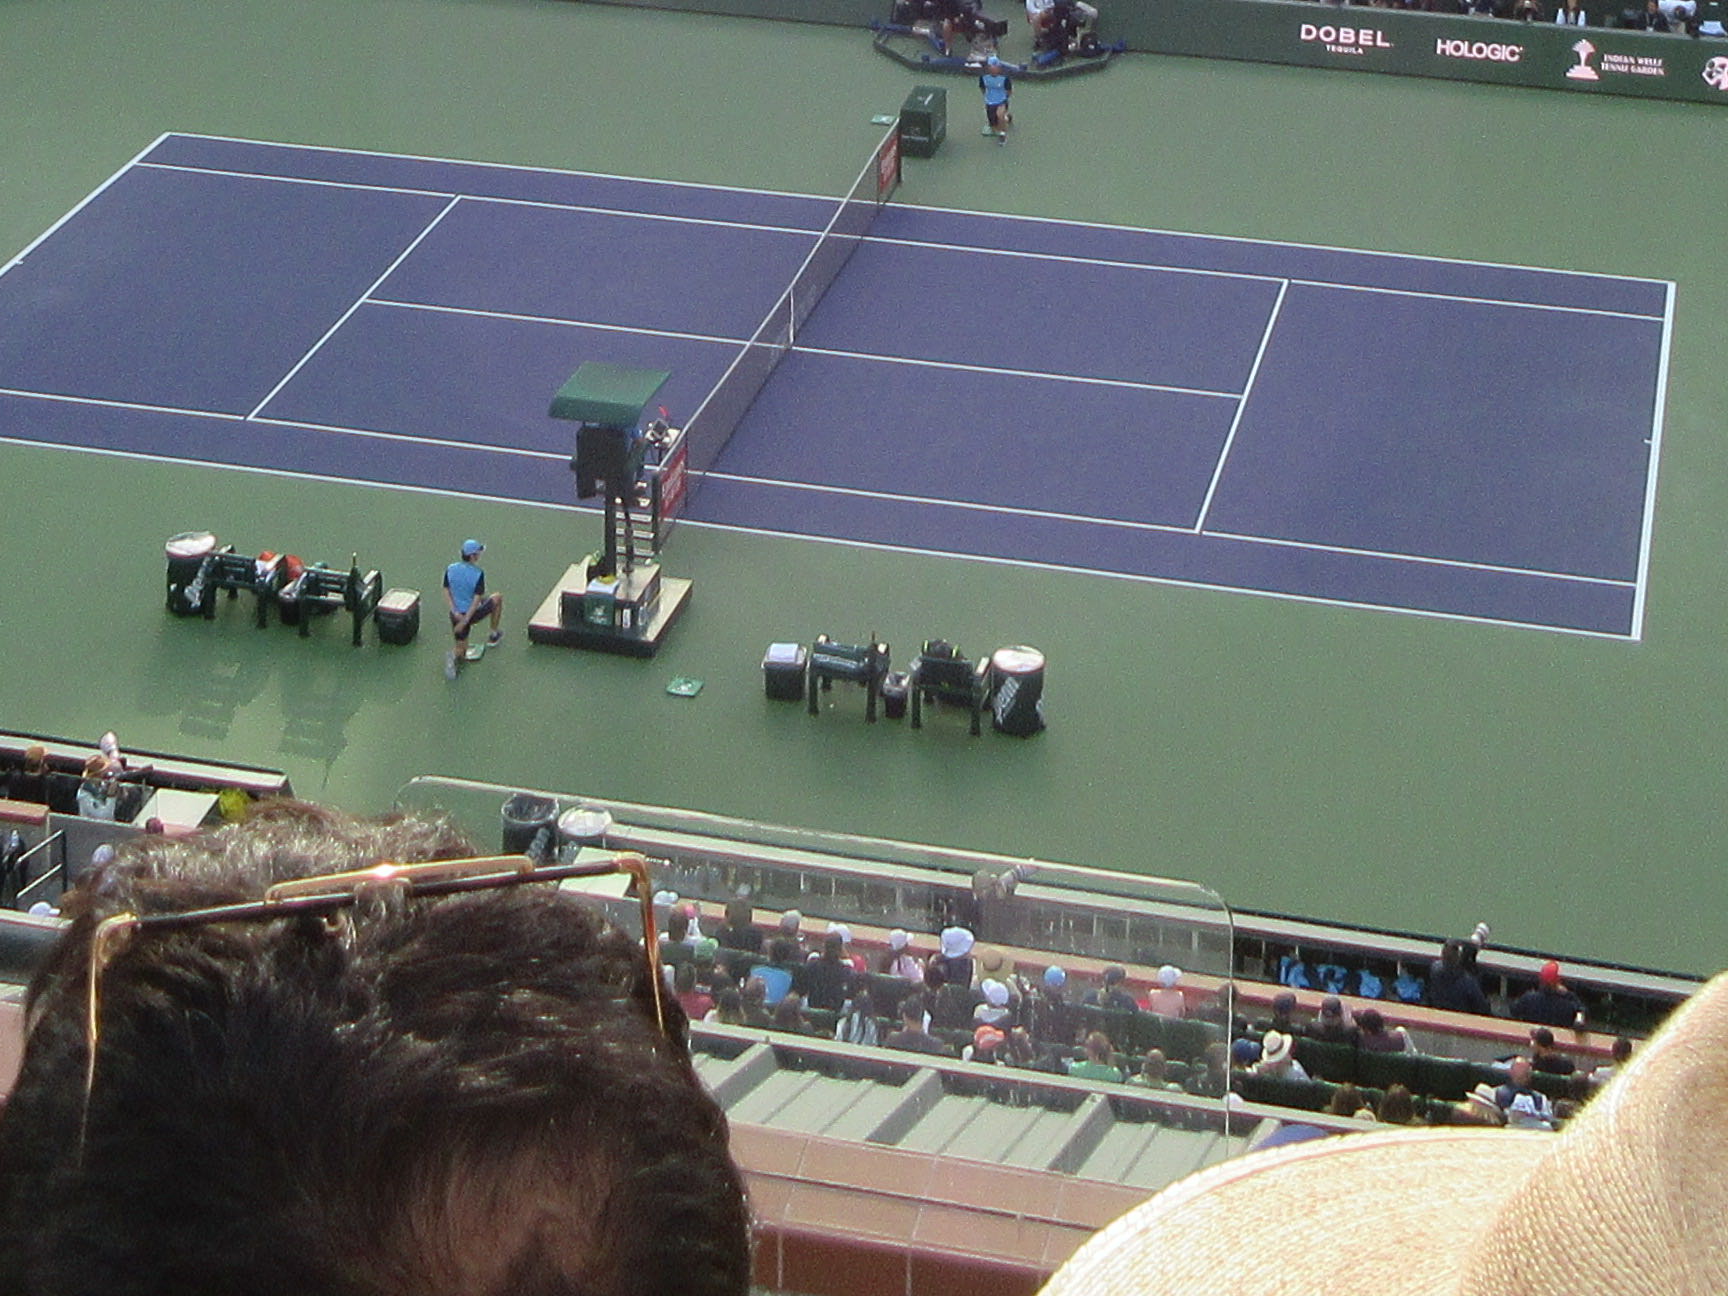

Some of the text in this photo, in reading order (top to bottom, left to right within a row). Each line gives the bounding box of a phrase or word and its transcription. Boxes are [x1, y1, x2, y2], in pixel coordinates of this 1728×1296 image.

[1300, 23, 1391, 48] DOBEL
[1325, 44, 1364, 55] TEQUILA
[1436, 37, 1521, 62] HOLOGIC
[1603, 53, 1663, 68] INDIAN WELLS
[1600, 61, 1666, 76] TENNIS GARDEN
